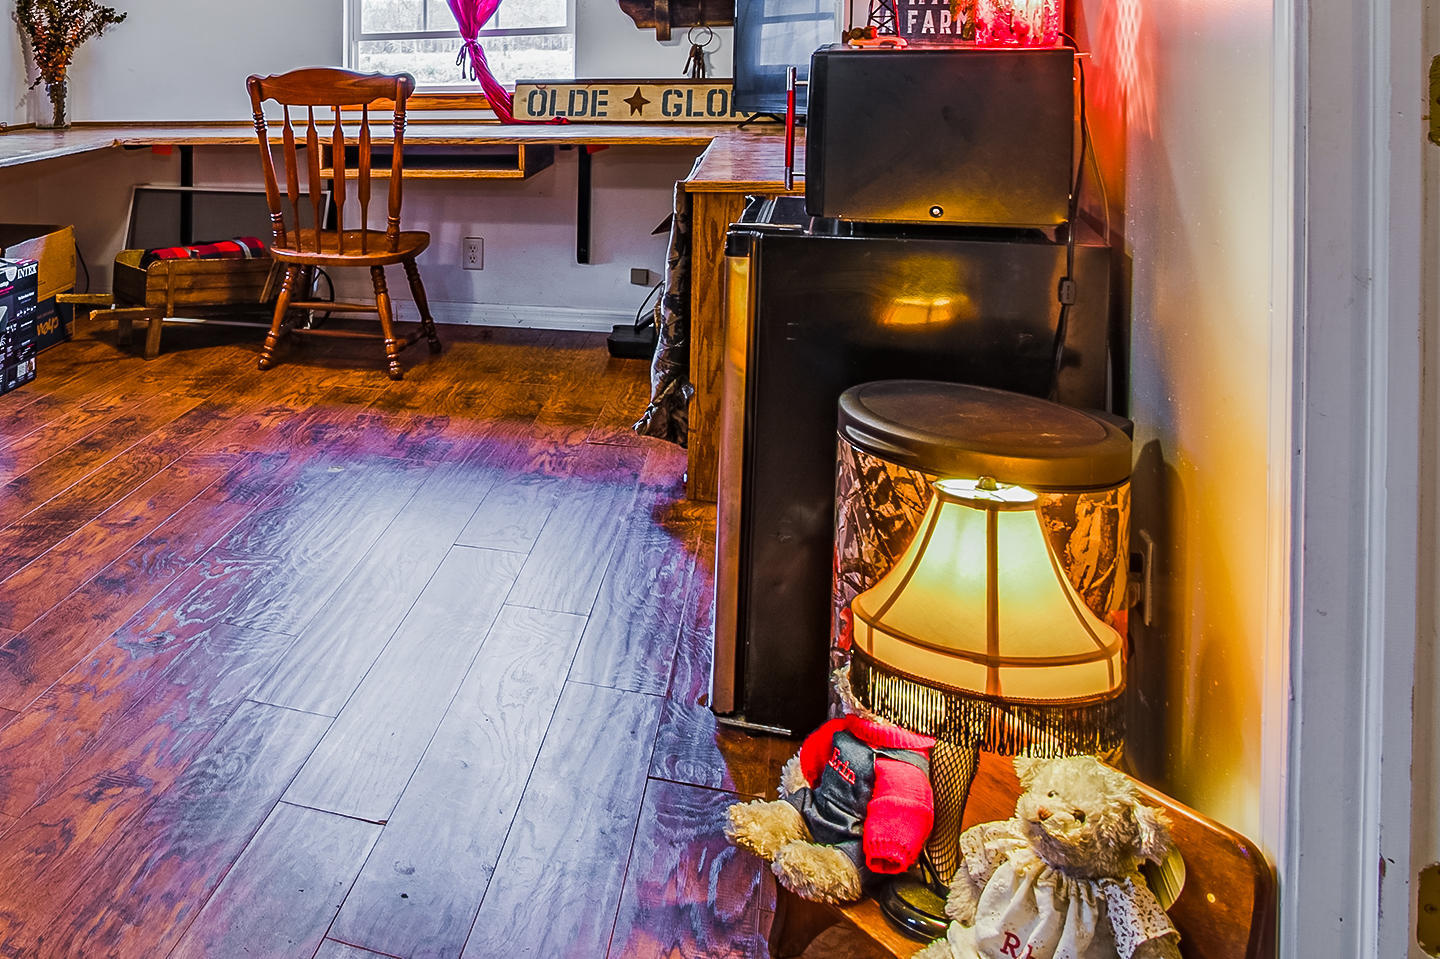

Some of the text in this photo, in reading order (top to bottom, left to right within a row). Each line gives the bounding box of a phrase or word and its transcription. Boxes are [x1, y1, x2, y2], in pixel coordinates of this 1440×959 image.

[527, 88, 609, 117] OLDE
[17, 263, 38, 280] INTEX
[828, 746, 857, 785] Erin
